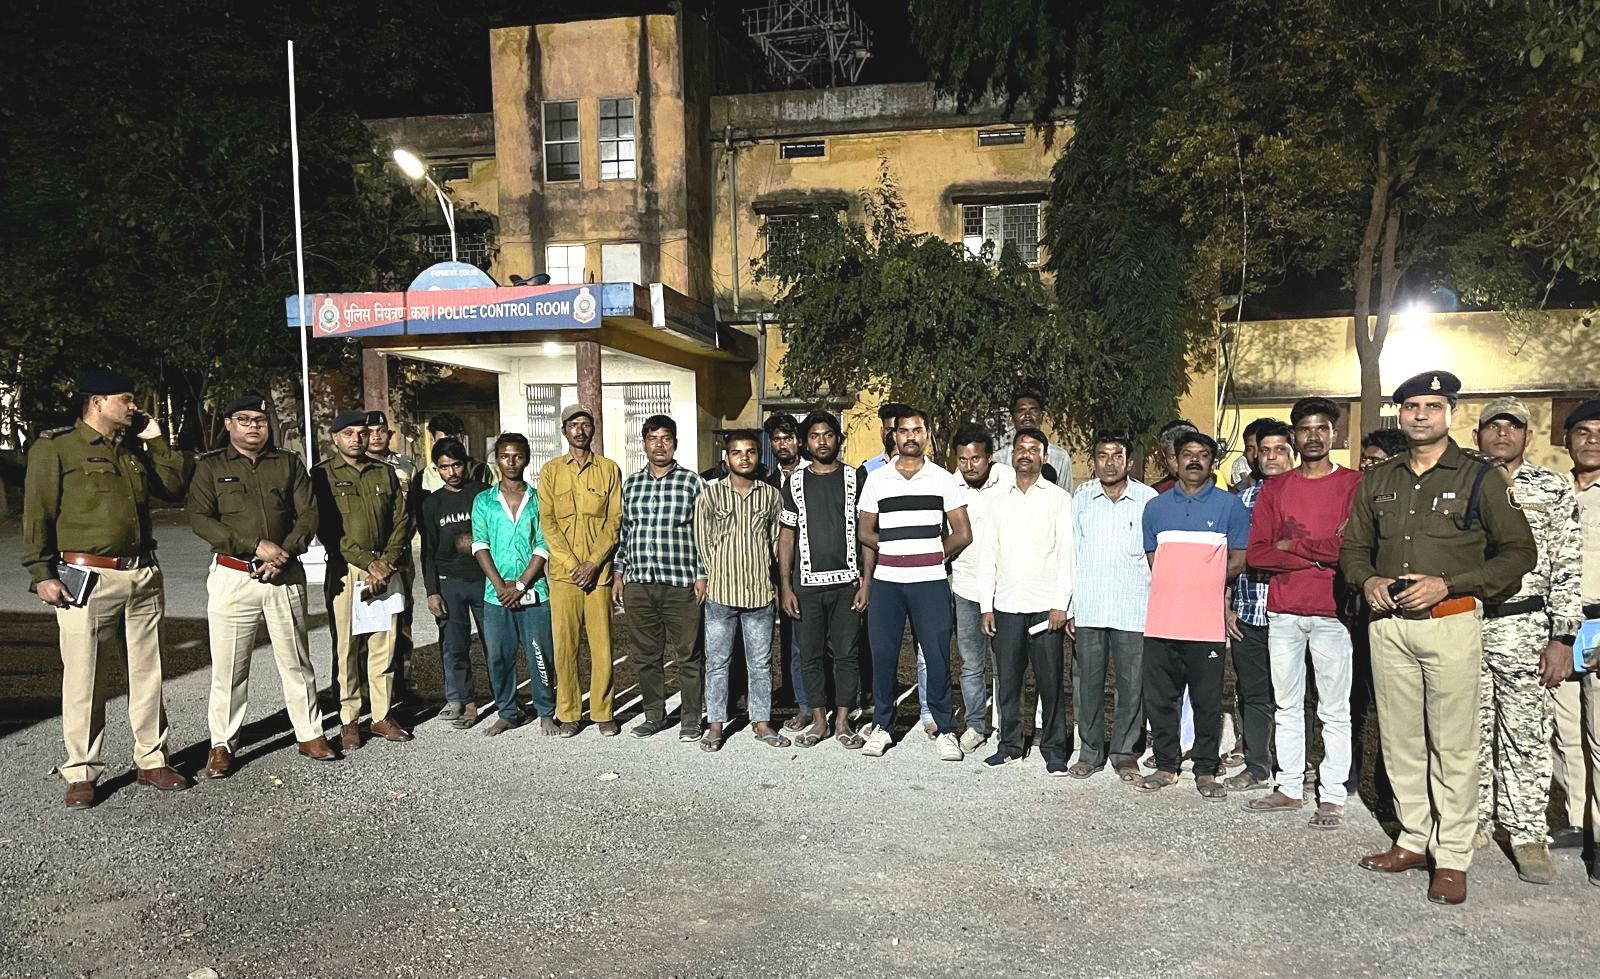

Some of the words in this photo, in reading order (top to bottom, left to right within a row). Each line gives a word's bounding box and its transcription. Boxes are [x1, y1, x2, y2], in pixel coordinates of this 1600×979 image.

[343, 302, 371, 327] पुलिस
[374, 302, 408, 321] नियंत्रण
[410, 305, 430, 322] कक्ष
[437, 305, 477, 320] POLICE
[480, 302, 533, 318] CONTROL
[535, 301, 570, 316] ROOM
